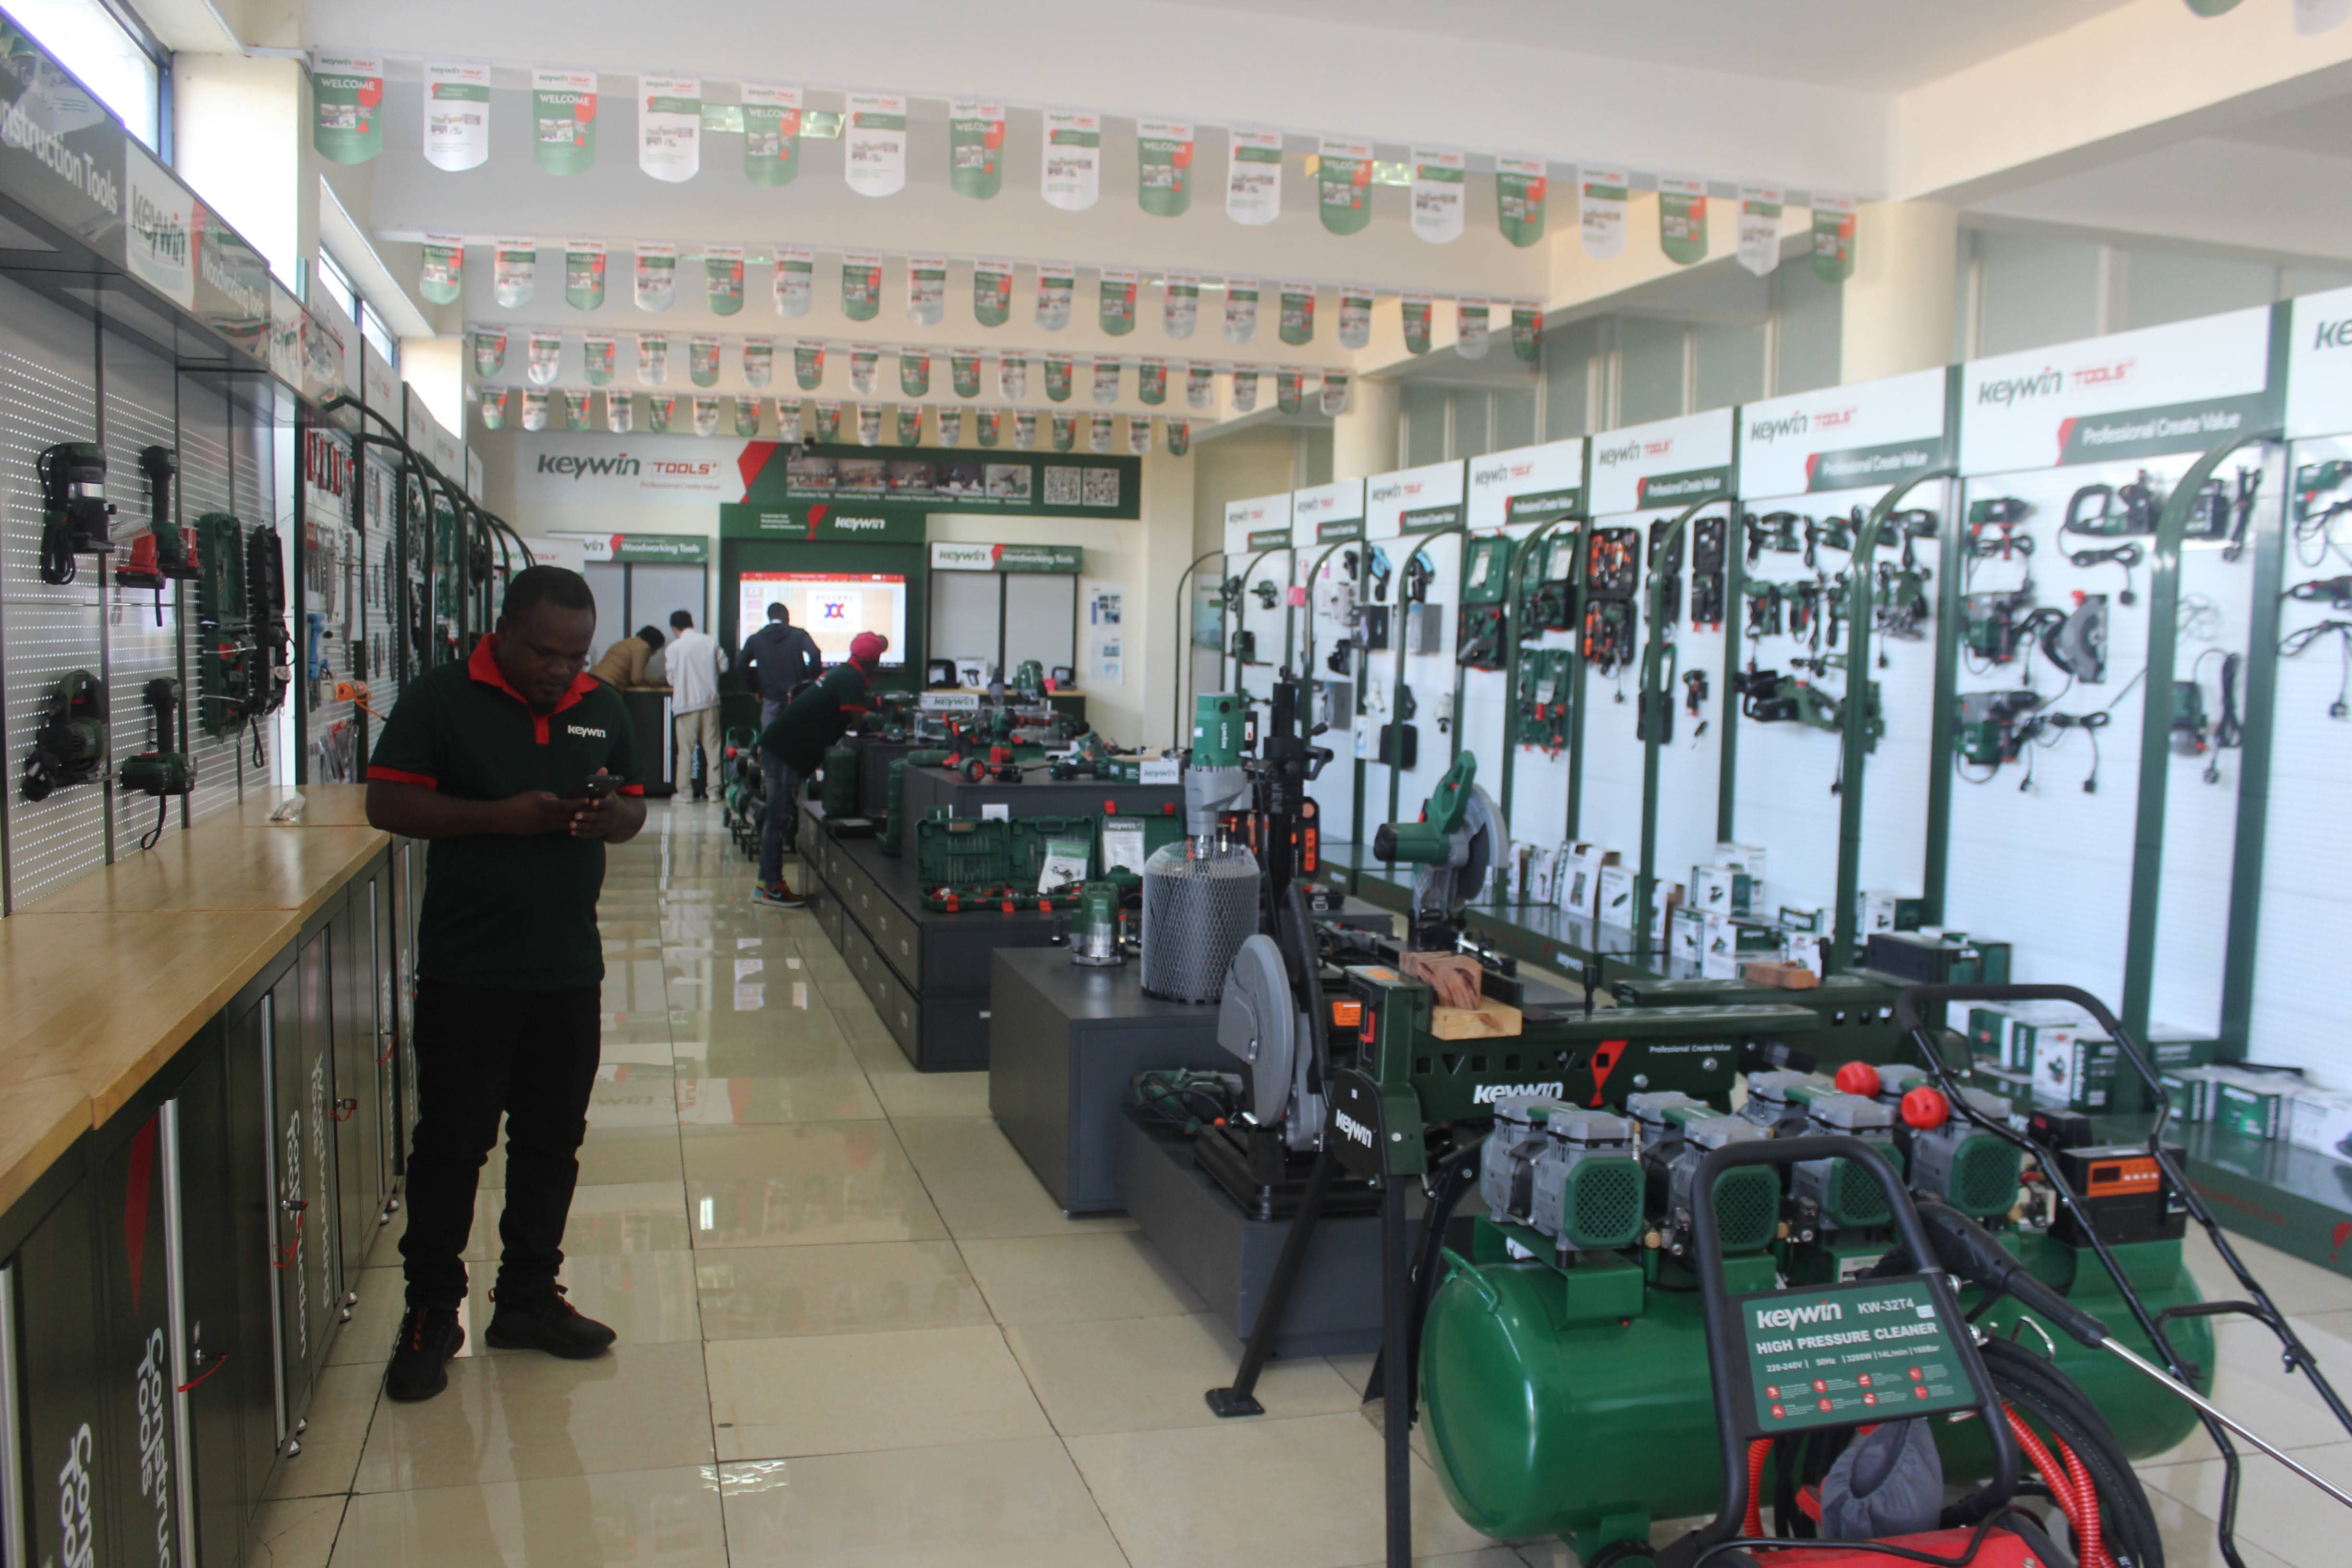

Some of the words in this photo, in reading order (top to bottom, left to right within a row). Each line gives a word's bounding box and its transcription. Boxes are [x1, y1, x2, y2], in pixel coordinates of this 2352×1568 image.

[321, 77, 375, 91] WELCOME
[539, 94, 590, 107] WELCOME
[749, 107, 795, 121] WELCOME
[955, 121, 999, 134] WELCOME
[83, 151, 118, 215] Tools
[131, 185, 185, 268] keywin
[1977, 365, 2062, 408] keywin
[2073, 364, 2126, 385] TOOLS
[1750, 409, 1808, 446] keywin
[1814, 411, 1851, 427] TOOLS
[2083, 420, 2156, 446] Professional
[2158, 416, 2201, 438] Create
[2202, 410, 2241, 431] Value
[1599, 439, 1640, 468] keywin
[537, 453, 641, 480] keywin
[653, 462, 710, 475] TOOLS
[835, 516, 885, 532] keywin
[621, 543, 678, 555] Woodworking
[679, 544, 701, 553] Tools
[939, 549, 986, 563] keywin
[568, 725, 606, 738] keywin
[1649, 1045, 1690, 1053] Professional
[1473, 1080, 1564, 1104] keywin
[1336, 1108, 1372, 1149] keywin
[1756, 1300, 1843, 1332] keywin
[1857, 1298, 1916, 1314] KW-32T4
[1756, 1339, 1794, 1355] HIGH
[1797, 1330, 1871, 1350] PRESSURE
[1874, 1322, 1939, 1340] CLEANER
